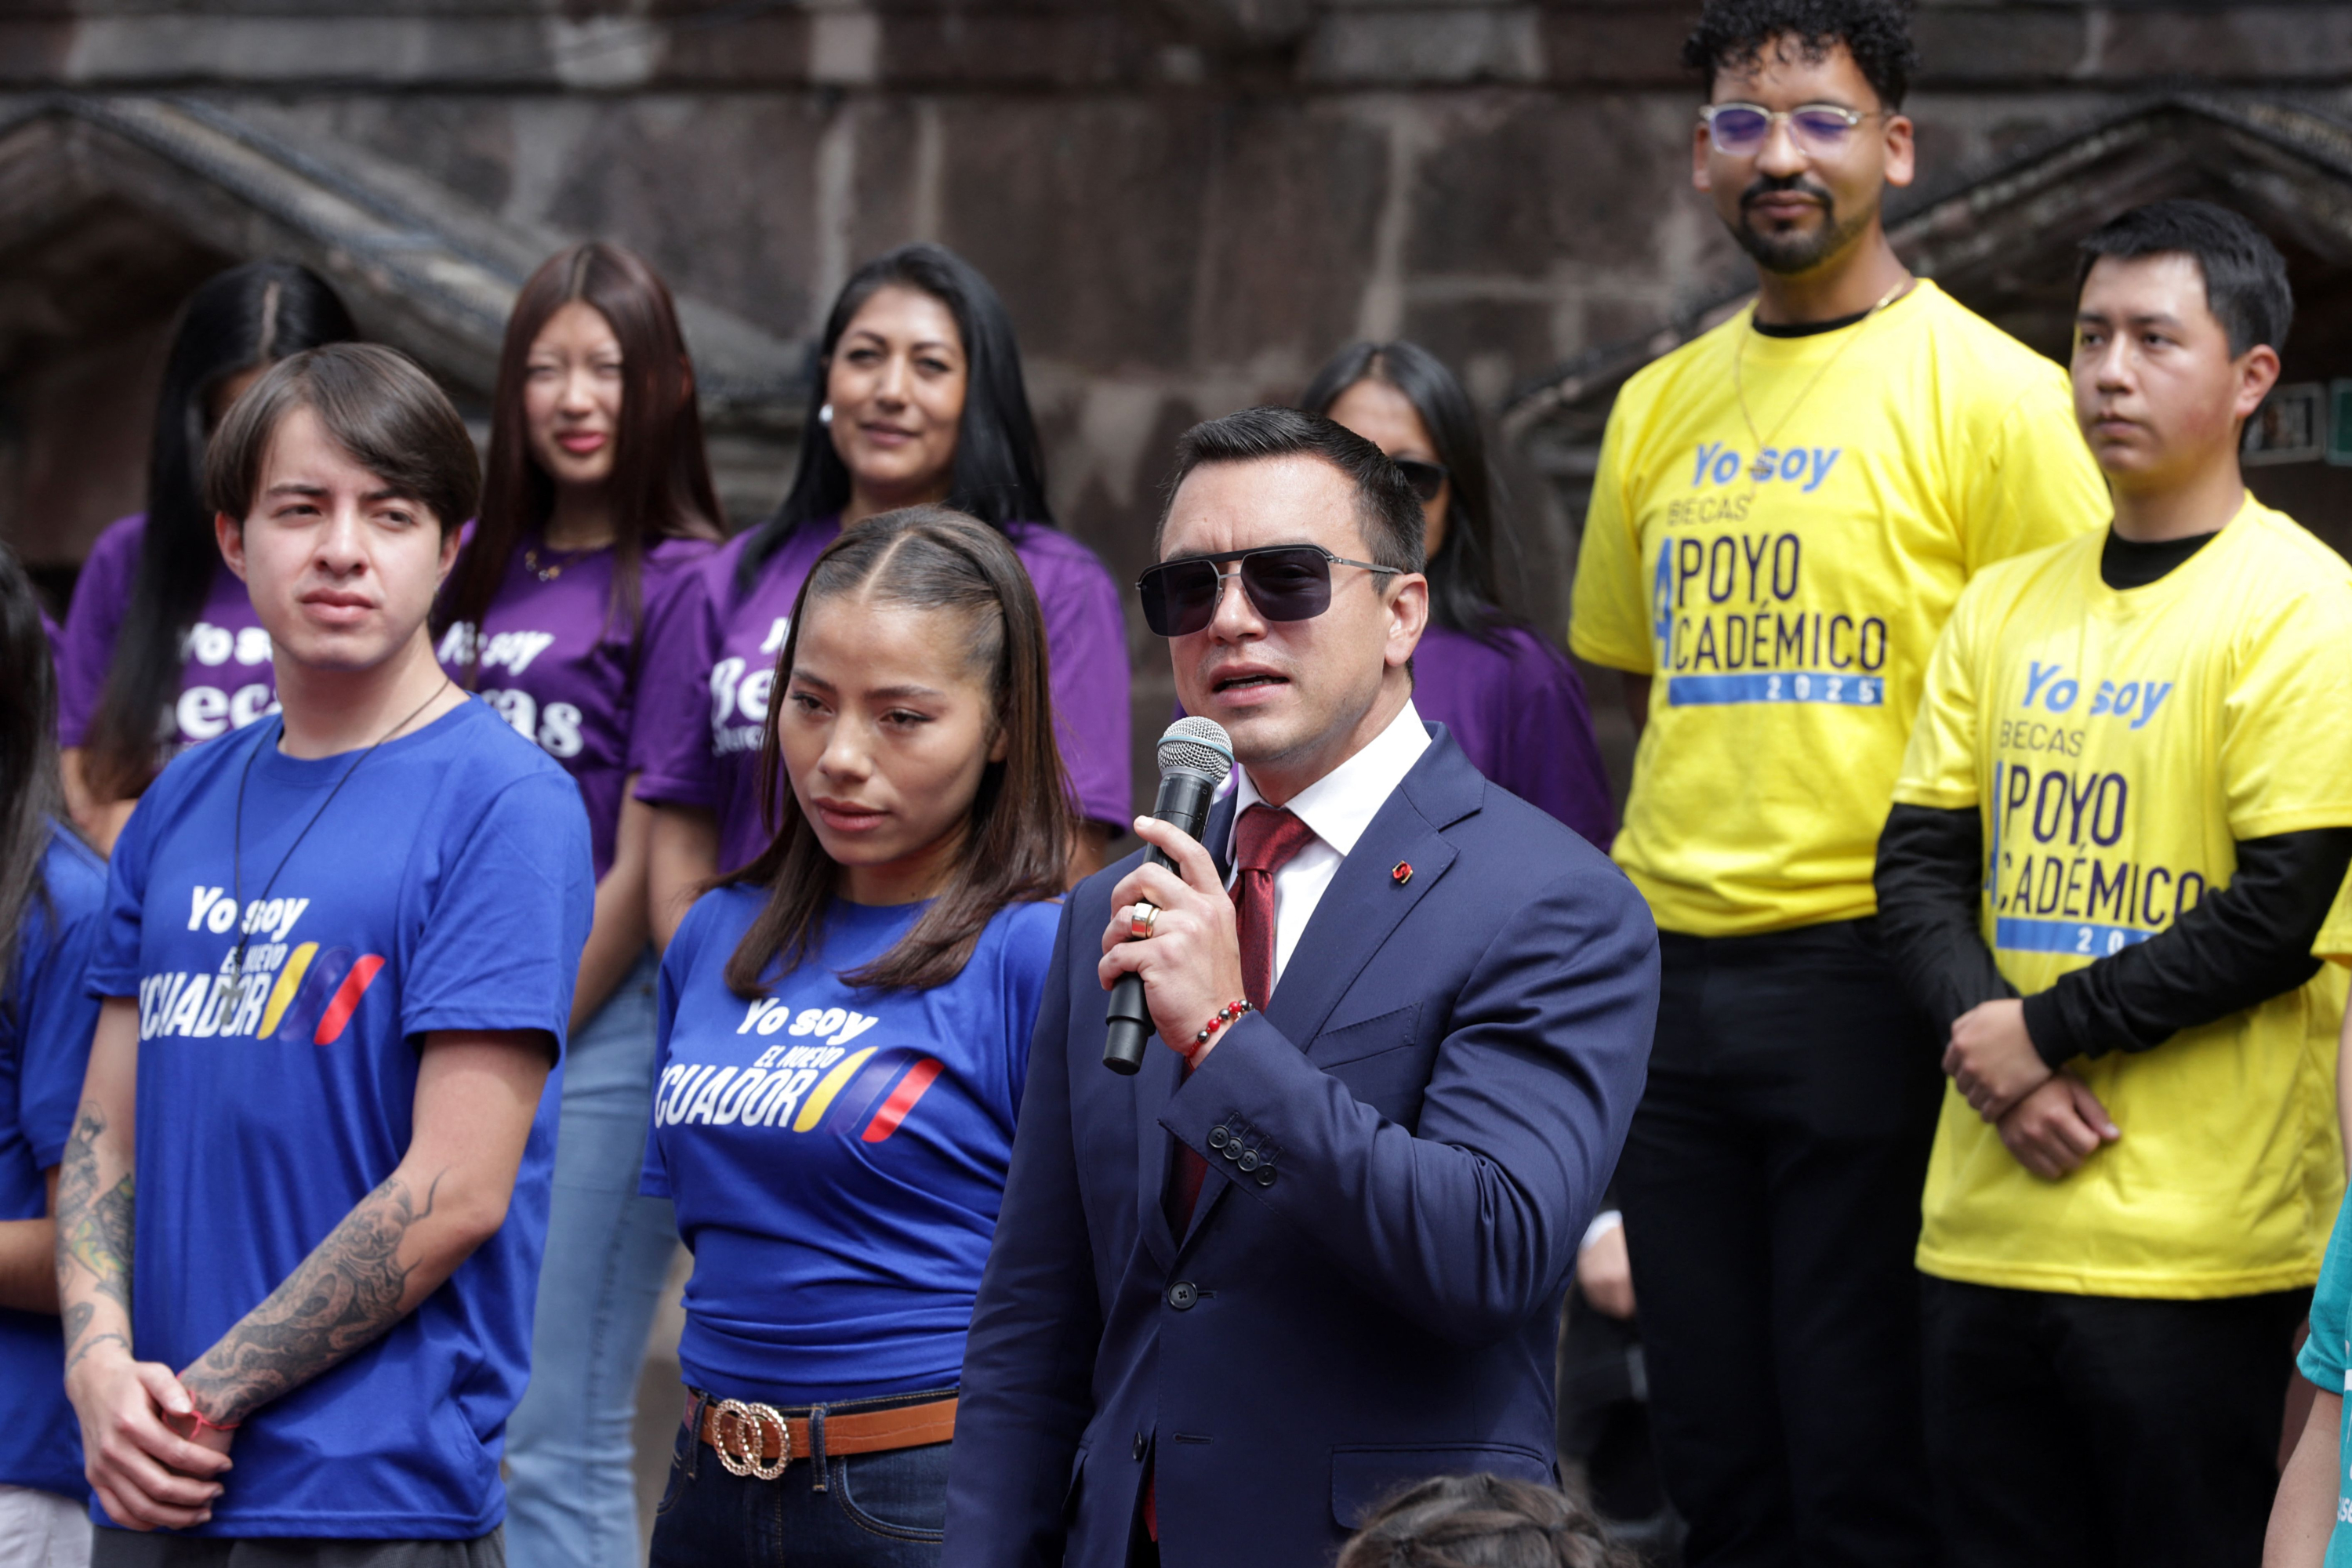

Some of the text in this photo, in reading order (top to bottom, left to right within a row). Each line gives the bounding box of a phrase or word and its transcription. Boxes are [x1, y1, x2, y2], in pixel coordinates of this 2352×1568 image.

[1690, 441, 1842, 493] Yo soy
[1667, 495, 1751, 527] BECAS
[1766, 673, 1876, 704] 2025
[2022, 661, 2174, 730] Yo soy
[2000, 720, 2085, 757] BECAS
[187, 885, 310, 943] Yo soy
[138, 971, 273, 1041] CUADOR
[736, 997, 880, 1046] Yo soy
[753, 1044, 846, 1069] EL NUEVO
[655, 1063, 819, 1129] CUADOR
